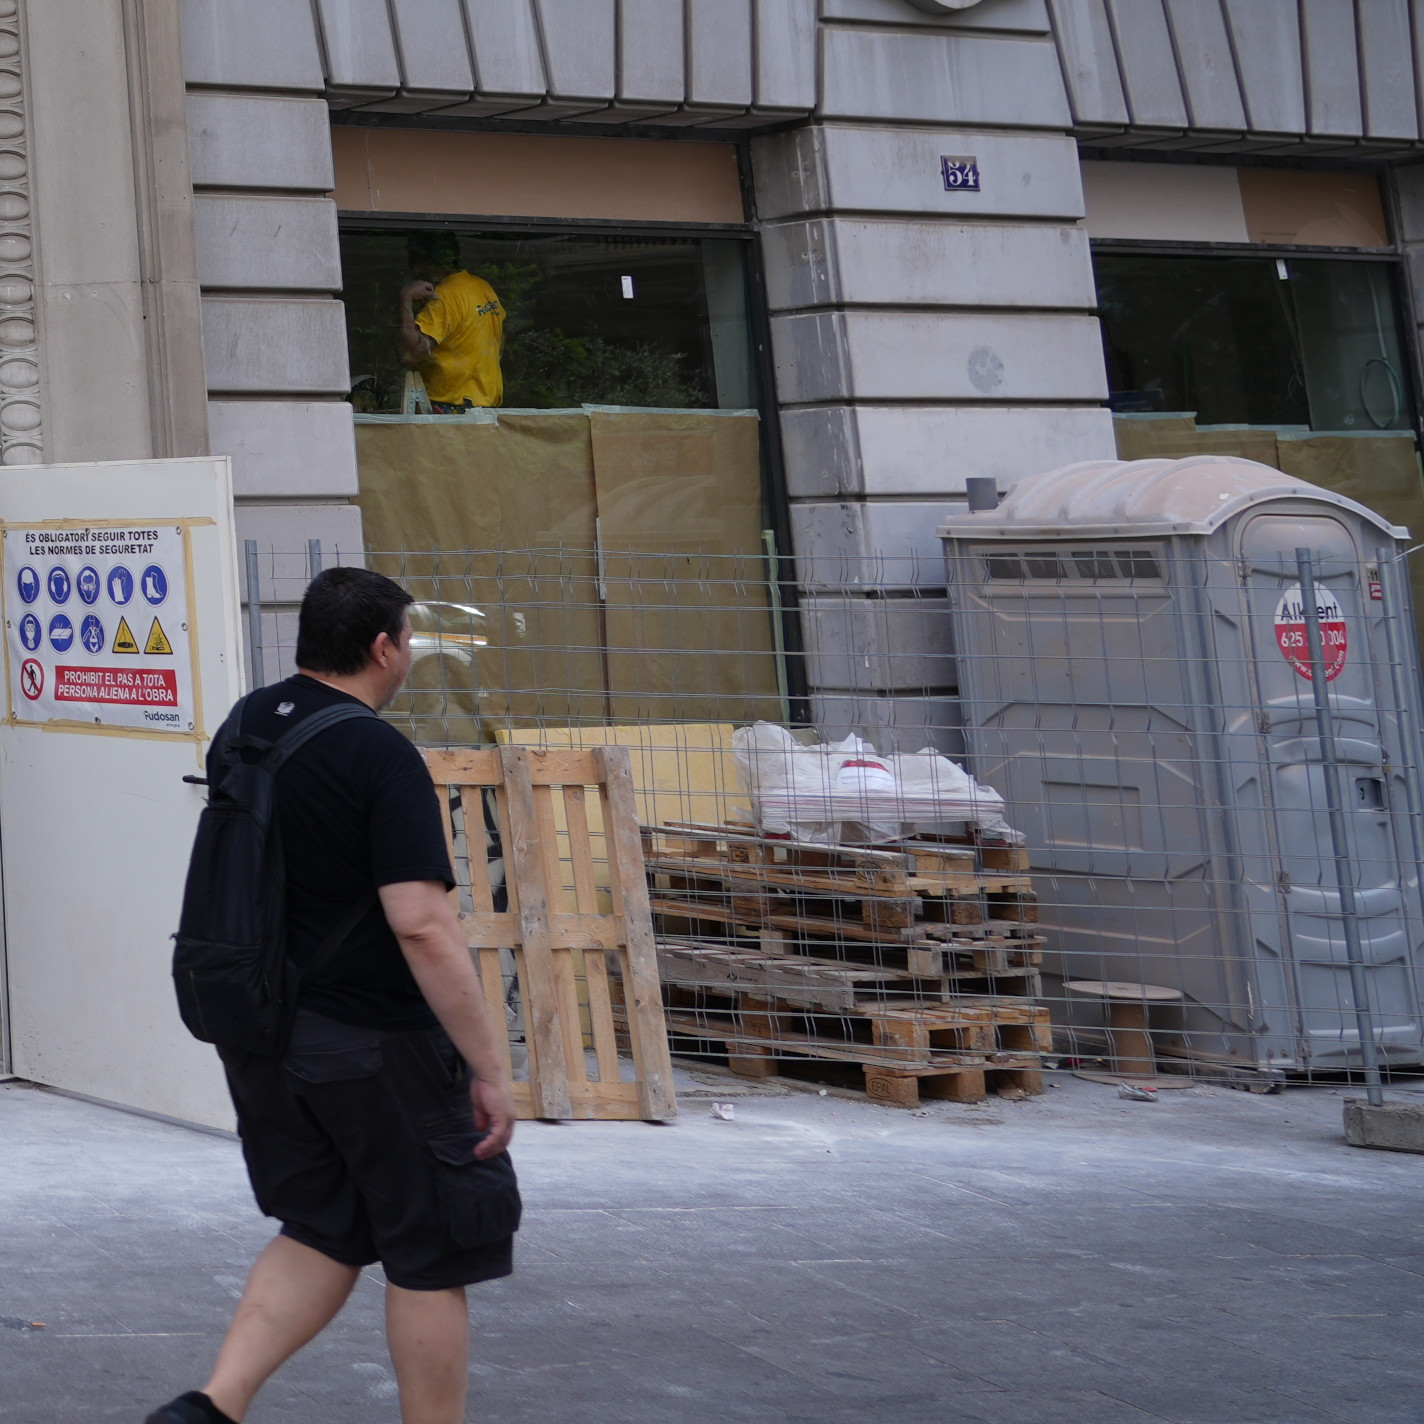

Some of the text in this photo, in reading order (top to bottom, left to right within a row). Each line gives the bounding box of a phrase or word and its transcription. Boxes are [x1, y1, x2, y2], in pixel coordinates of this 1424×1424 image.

[948, 160, 976, 186] 54
[26, 530, 158, 542] ÉS OBLIGATORI SEGUIR TOTES
[29, 544, 154, 555] LES NORMES DE SEGURETAT
[1281, 632, 1303, 647] 625
[64, 670, 166, 686] PROHIBIT EL PAS A TOTA
[58, 684, 174, 701] PERSONA ALIENA A L'OBRA
[144, 710, 180, 722] Fudosan
